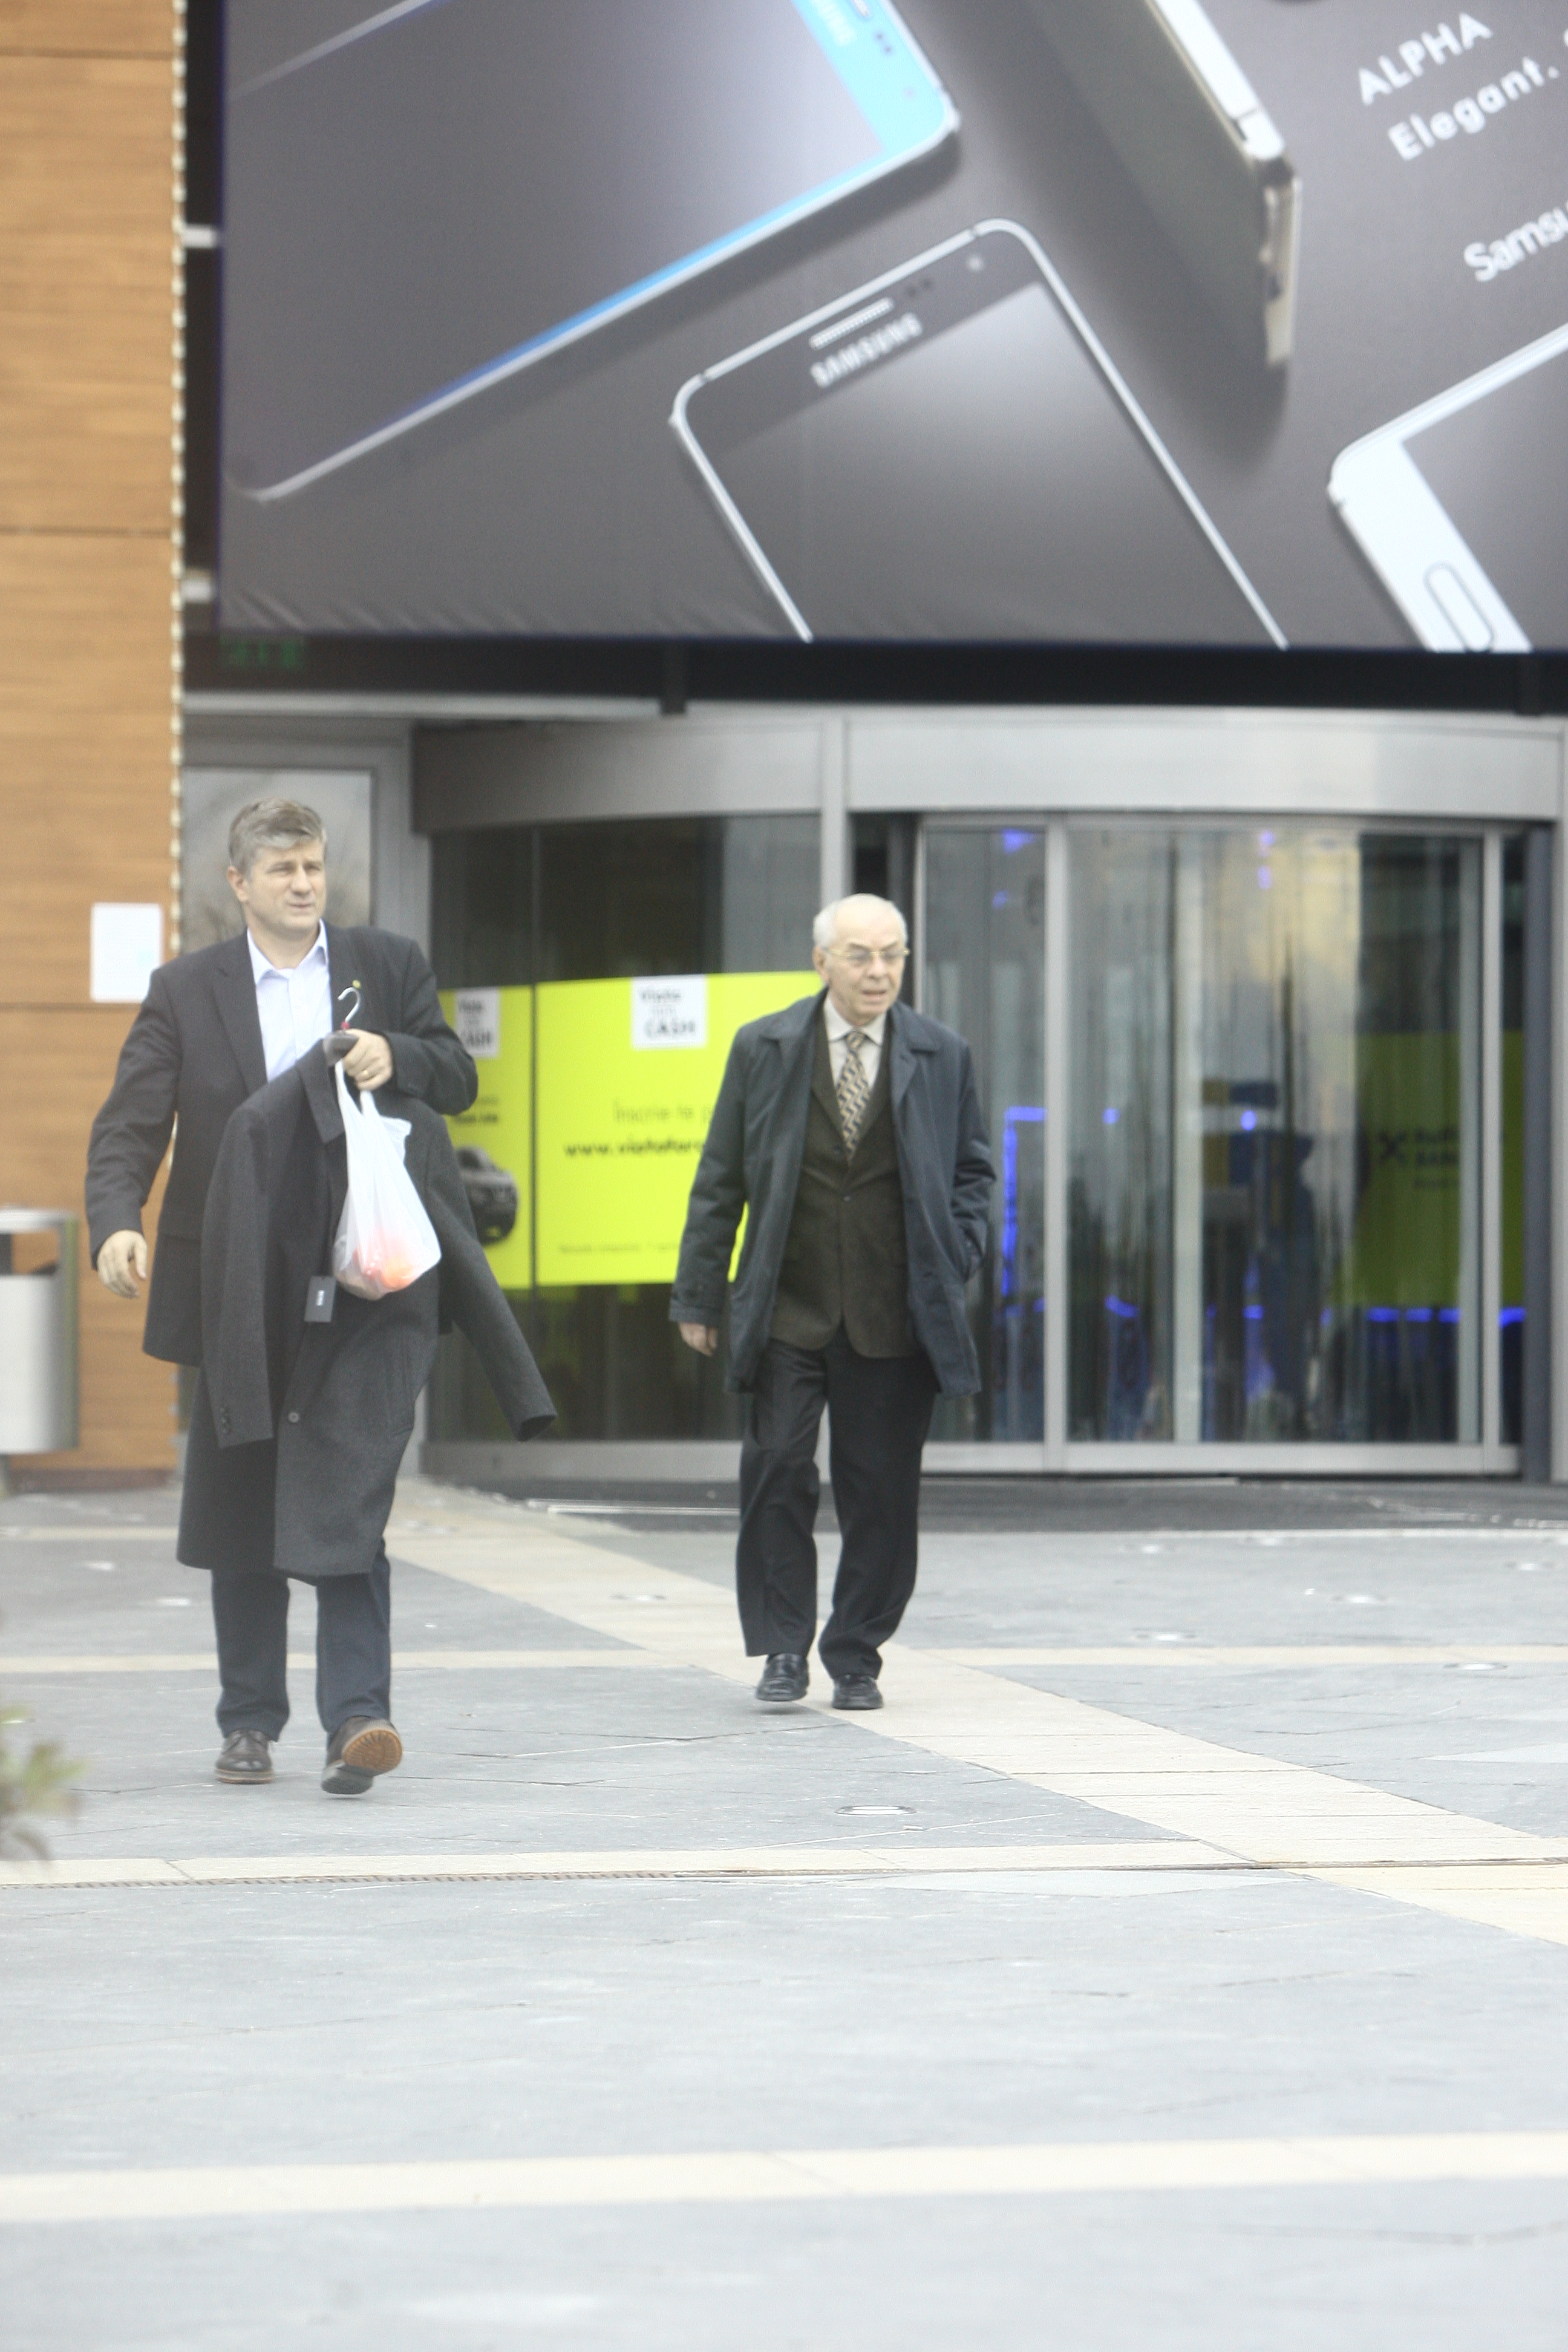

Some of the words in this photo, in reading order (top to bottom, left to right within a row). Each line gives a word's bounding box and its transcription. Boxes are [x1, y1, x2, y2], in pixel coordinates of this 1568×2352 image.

[1359, 12, 1494, 105] ALPHA
[1388, 56, 1559, 160] Elegant.
[810, 313, 923, 388] SAMSUNG
